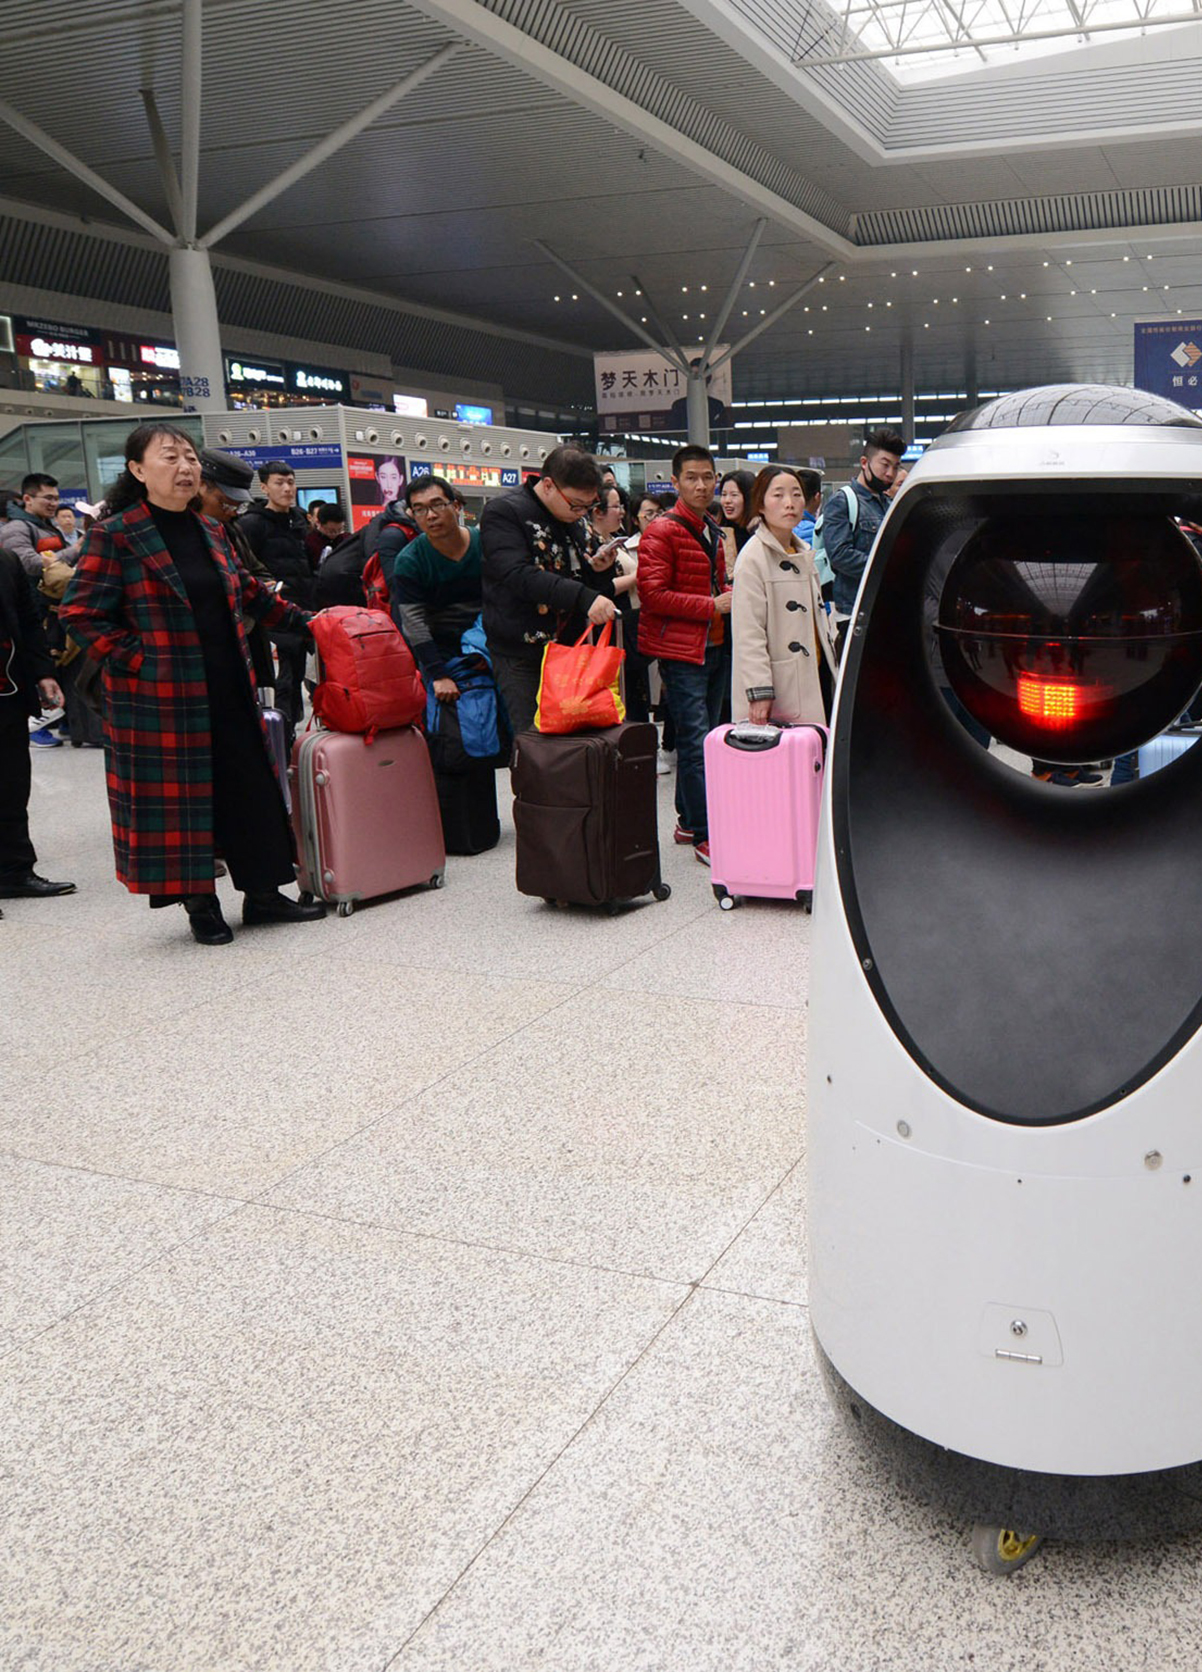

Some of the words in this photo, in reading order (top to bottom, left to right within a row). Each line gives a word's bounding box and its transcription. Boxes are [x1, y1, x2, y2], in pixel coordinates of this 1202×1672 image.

[600, 369, 680, 391] 梦天木门
[412, 466, 430, 477] A26
[502, 473, 516, 484] A27
